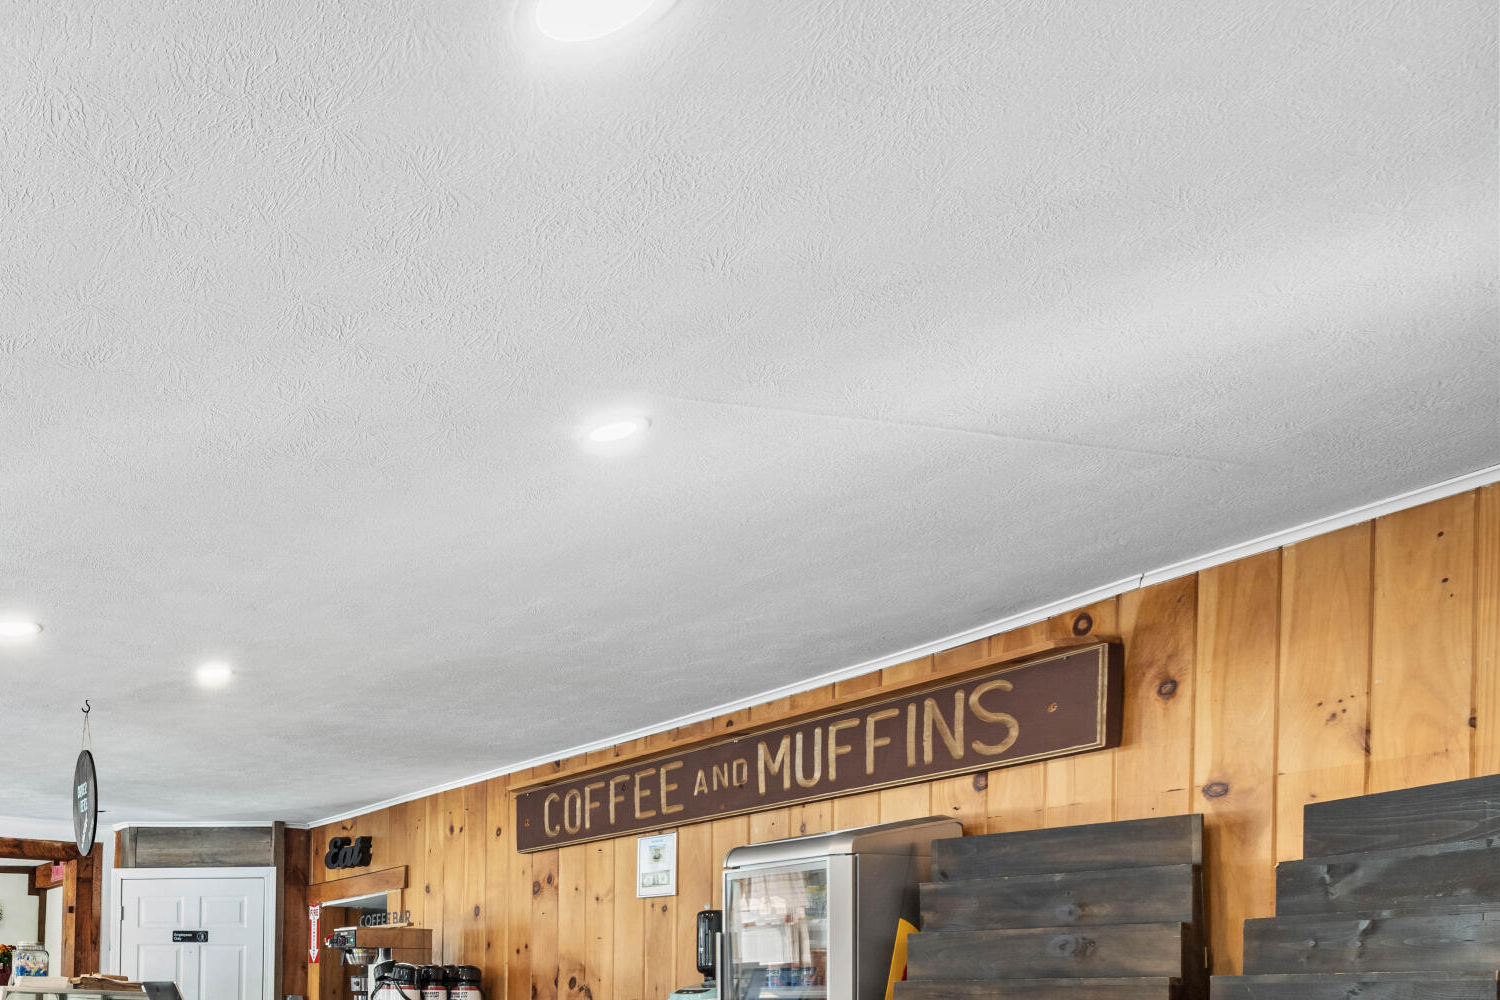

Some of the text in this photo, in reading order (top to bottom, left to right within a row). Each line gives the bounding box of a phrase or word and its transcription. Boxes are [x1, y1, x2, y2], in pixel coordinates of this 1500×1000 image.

[544, 679, 1019, 838] COFFEE AND MUFFINS
[325, 836, 371, 869] Eat
[360, 909, 411, 928] COFFEE BAR
